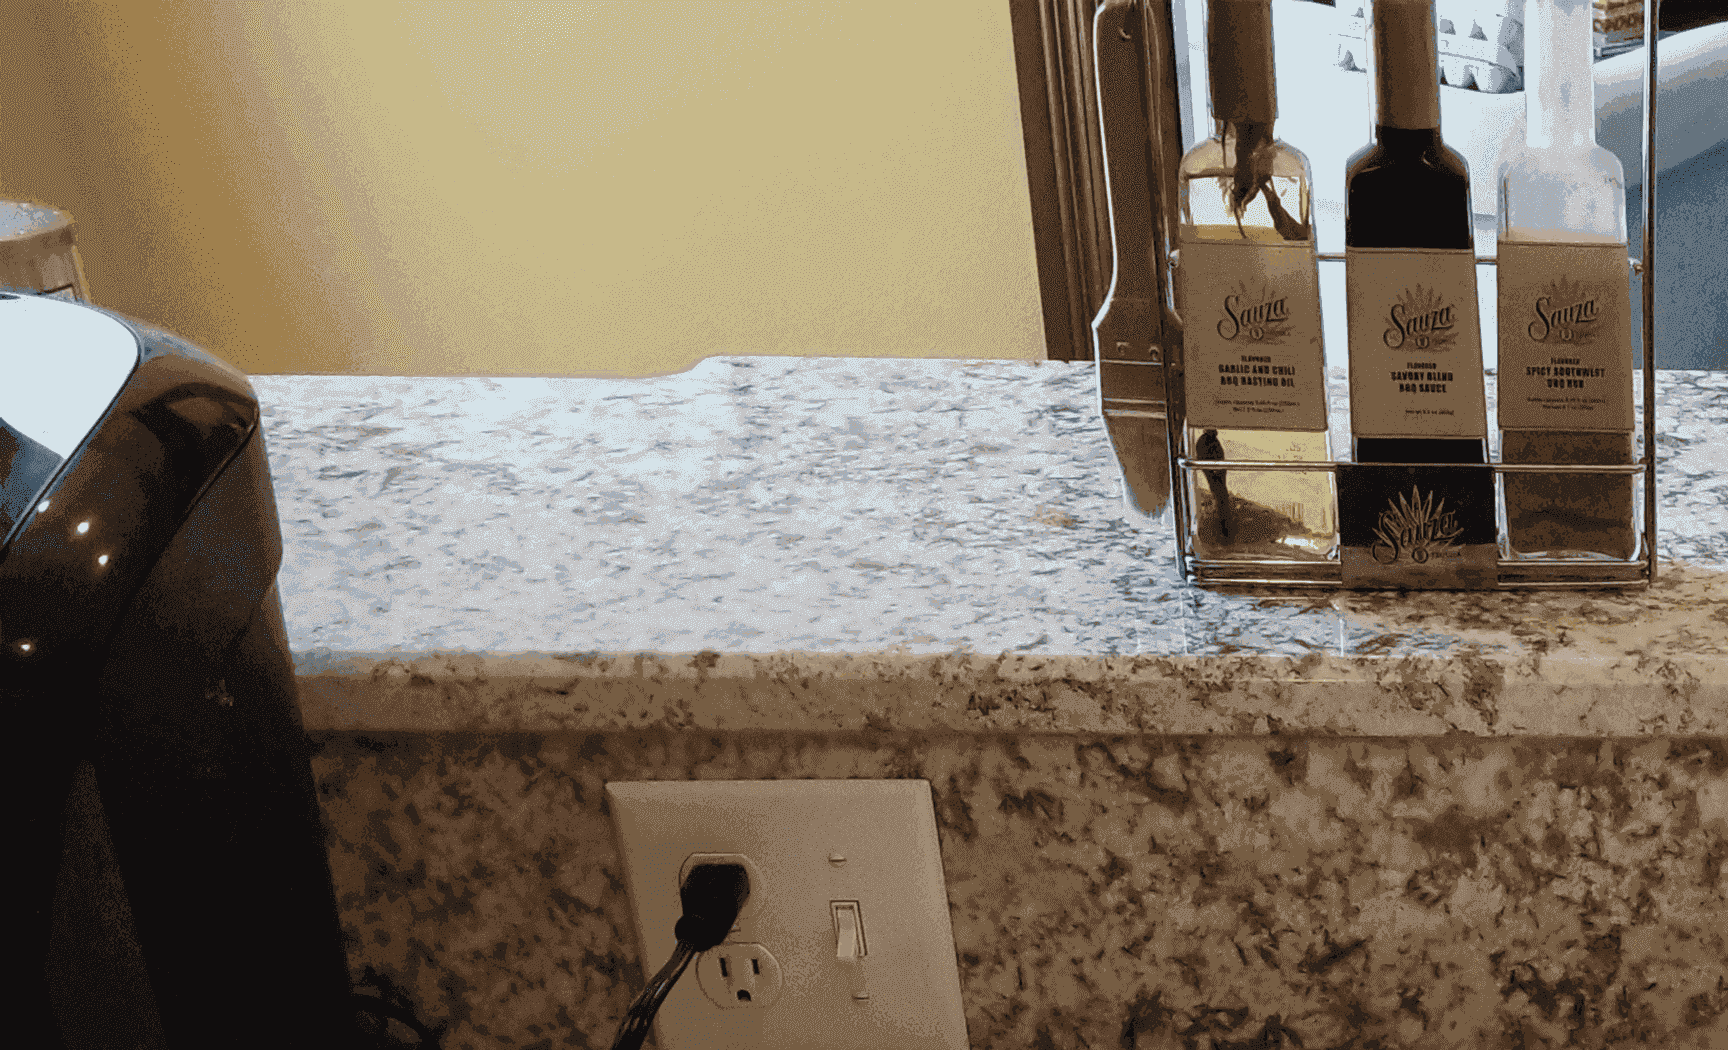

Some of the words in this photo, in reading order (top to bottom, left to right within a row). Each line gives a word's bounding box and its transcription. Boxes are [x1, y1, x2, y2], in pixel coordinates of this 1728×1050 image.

[1217, 295, 1291, 341] Sauza
[1528, 296, 1599, 342] Sauza
[1383, 303, 1455, 350] Sauza
[1218, 364, 1250, 374] GARLIC
[1252, 365, 1270, 375] AND
[1272, 366, 1296, 376] CHILI
[1391, 371, 1424, 381] SAVORY
[1526, 366, 1551, 376] SPICY
[1281, 377, 1295, 388] OIL
[1419, 383, 1447, 393] SAUCE
[1371, 510, 1463, 564] Sauza
